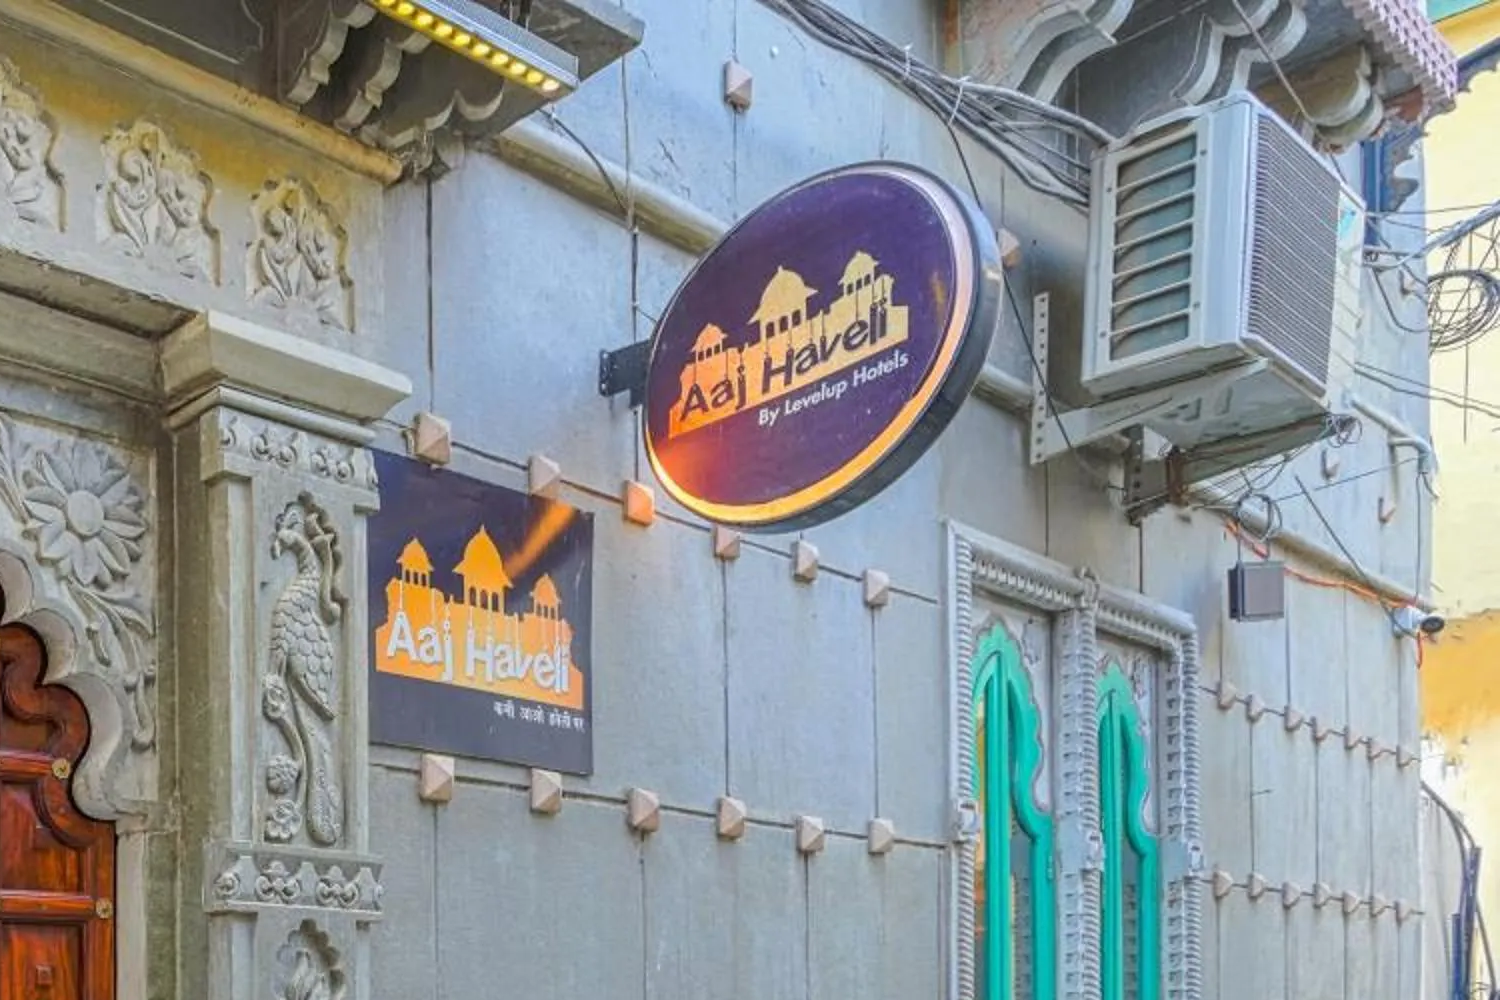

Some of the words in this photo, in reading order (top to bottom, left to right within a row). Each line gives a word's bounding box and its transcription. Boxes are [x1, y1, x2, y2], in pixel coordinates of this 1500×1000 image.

[680, 364, 746, 421] Aaj
[762, 298, 887, 394] Haveli
[758, 408, 779, 427] By
[784, 379, 847, 416] Levelup
[852, 350, 909, 387] Hotels
[387, 611, 453, 682] Aaj
[466, 624, 571, 693] Haveli
